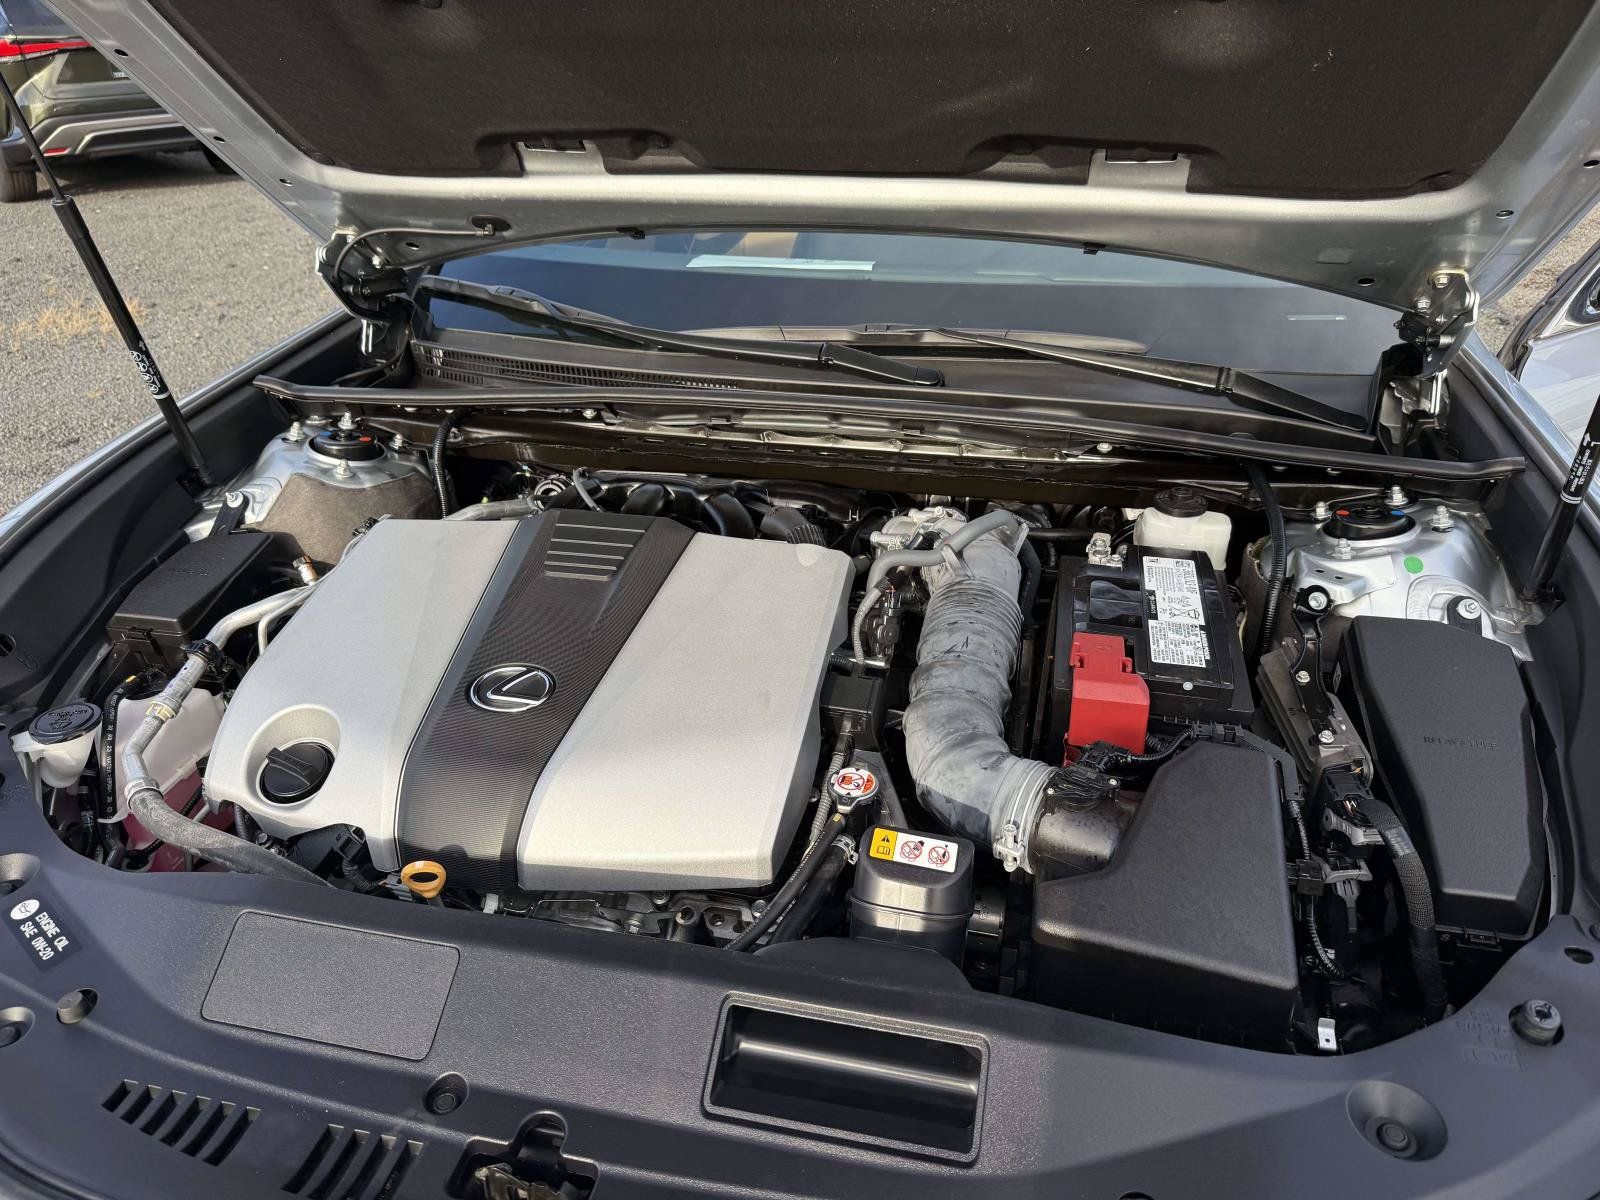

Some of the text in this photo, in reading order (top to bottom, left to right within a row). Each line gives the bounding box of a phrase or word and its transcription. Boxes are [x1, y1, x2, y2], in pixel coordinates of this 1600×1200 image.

[20, 921, 55, 960] SAE 0W-20
[35, 911, 70, 952] ENGINE OIL
